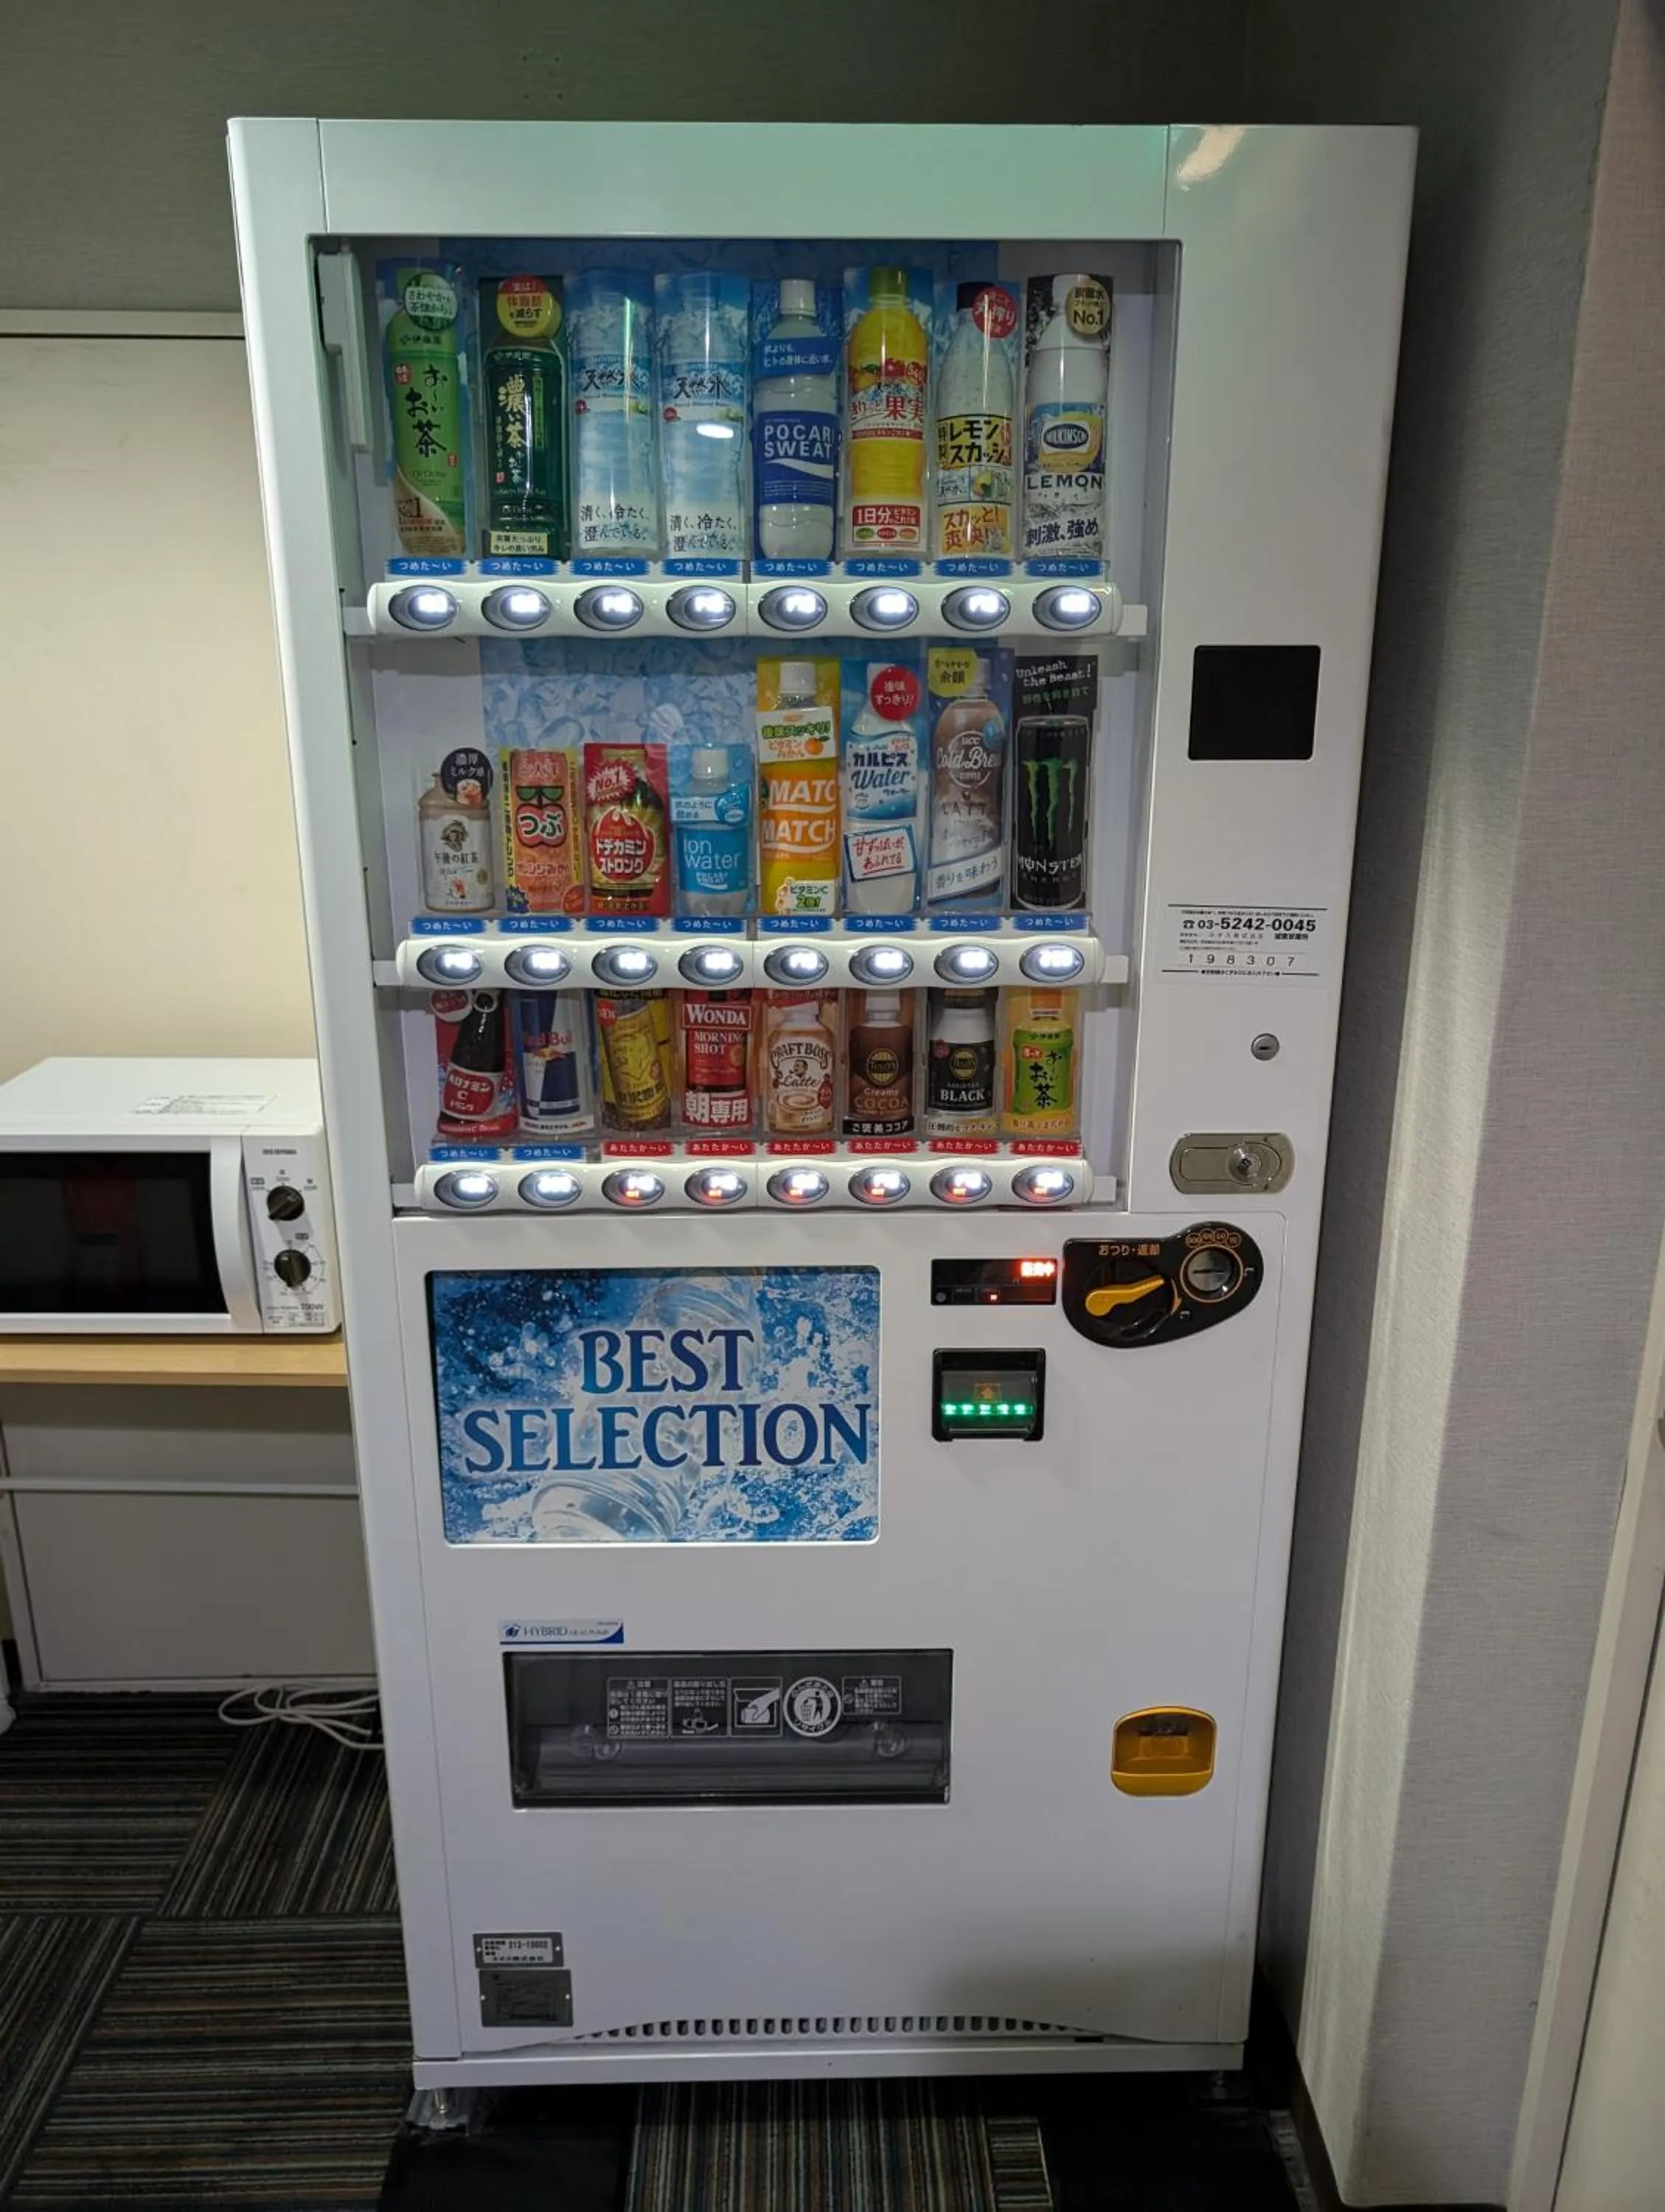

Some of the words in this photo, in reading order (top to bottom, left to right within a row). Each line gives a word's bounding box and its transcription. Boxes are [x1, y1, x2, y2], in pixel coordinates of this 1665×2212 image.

[1074, 308, 1104, 326] No.1
[582, 369, 641, 392] 天然水
[672, 375, 732, 400] 天然水
[405, 387, 447, 458] お茶
[950, 420, 999, 441] レモン
[764, 440, 832, 461] SWEAT
[1027, 474, 1102, 490] LEMON
[1026, 517, 1099, 548] 刺激、強め
[1023, 677, 1046, 688] the
[853, 752, 908, 768] カルピス
[850, 768, 911, 790] Water
[762, 819, 836, 843] MATCH
[594, 838, 647, 856] ドデカミン
[684, 837, 712, 855] Ion
[598, 857, 644, 874] ストロング
[1198, 916, 1316, 932] 03-5242-0045
[686, 1003, 746, 1025] WONDA
[693, 1043, 728, 1055] SHOT
[771, 1042, 804, 1070] CRAFT
[779, 1073, 820, 1087] Latte
[854, 1096, 910, 1110] COCOA
[940, 1088, 986, 1102] BLACK
[685, 1091, 749, 1124] 朝専用
[1098, 1243, 1161, 1256] おつり・返却
[579, 1329, 754, 1394] BEST
[463, 1403, 872, 1473] SELECTION
[524, 1627, 568, 1636] HYBRID
